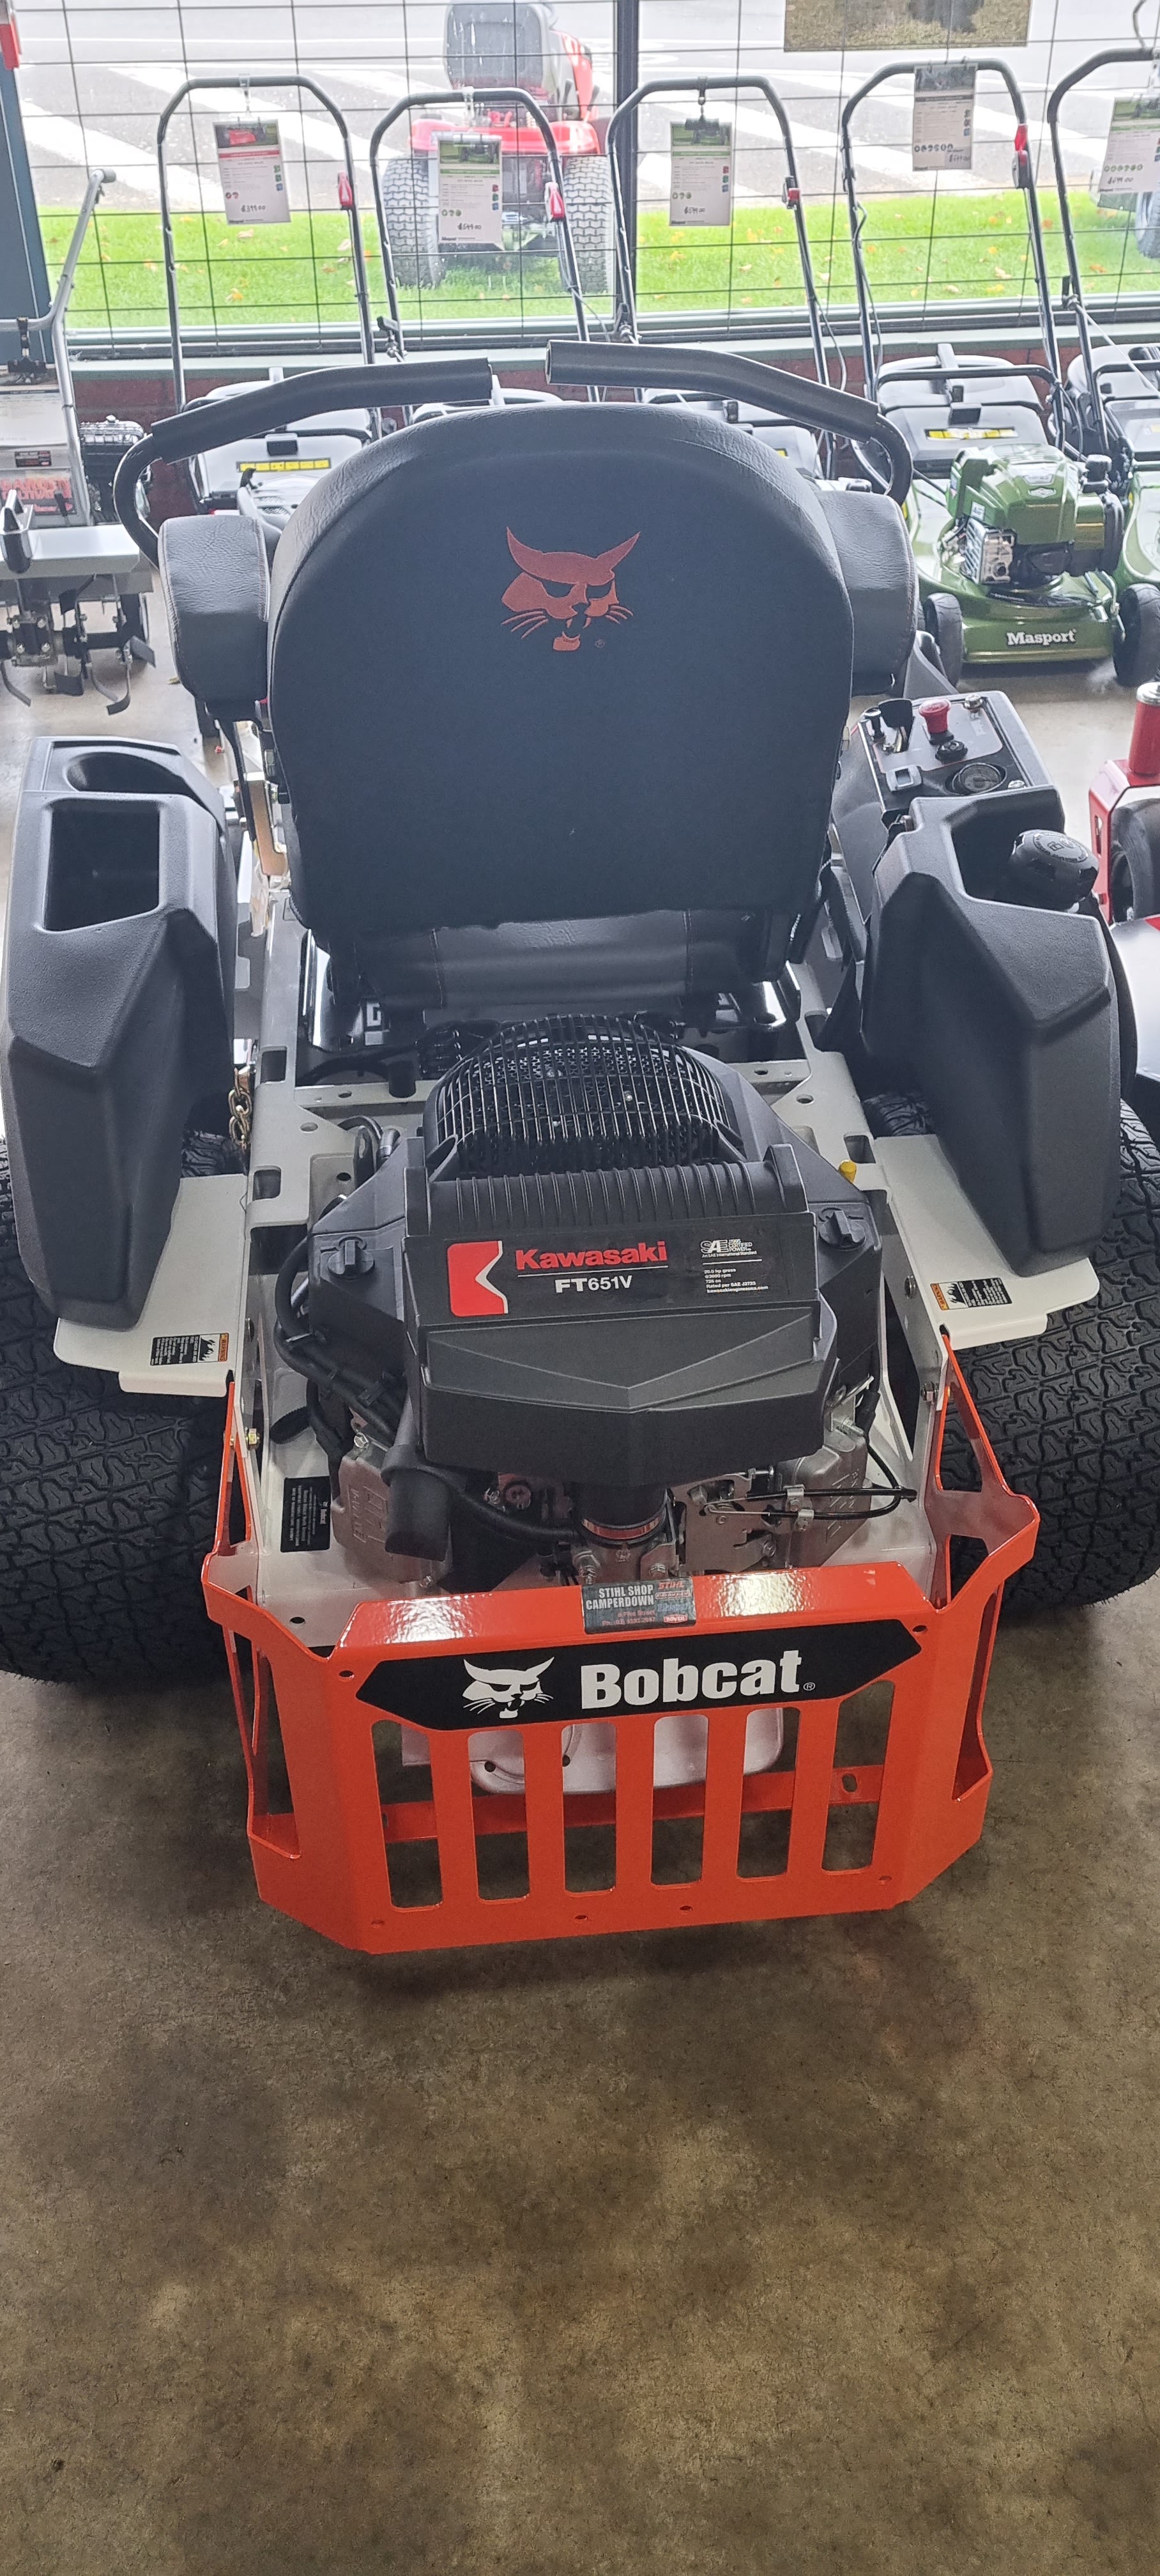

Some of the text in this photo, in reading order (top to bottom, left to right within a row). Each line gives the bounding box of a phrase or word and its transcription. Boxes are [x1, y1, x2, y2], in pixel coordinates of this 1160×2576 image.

[1006, 629, 1076, 646] Masport
[700, 1239, 729, 1254] SAE
[515, 1241, 668, 1270] Kawasaki
[554, 1275, 632, 1293] FT651V
[599, 1584, 654, 1598] STIHL SHOP
[659, 1581, 685, 1590] STIHL
[586, 1595, 654, 1610] CAMPERDOWN
[581, 1650, 801, 1709] Bobcat
